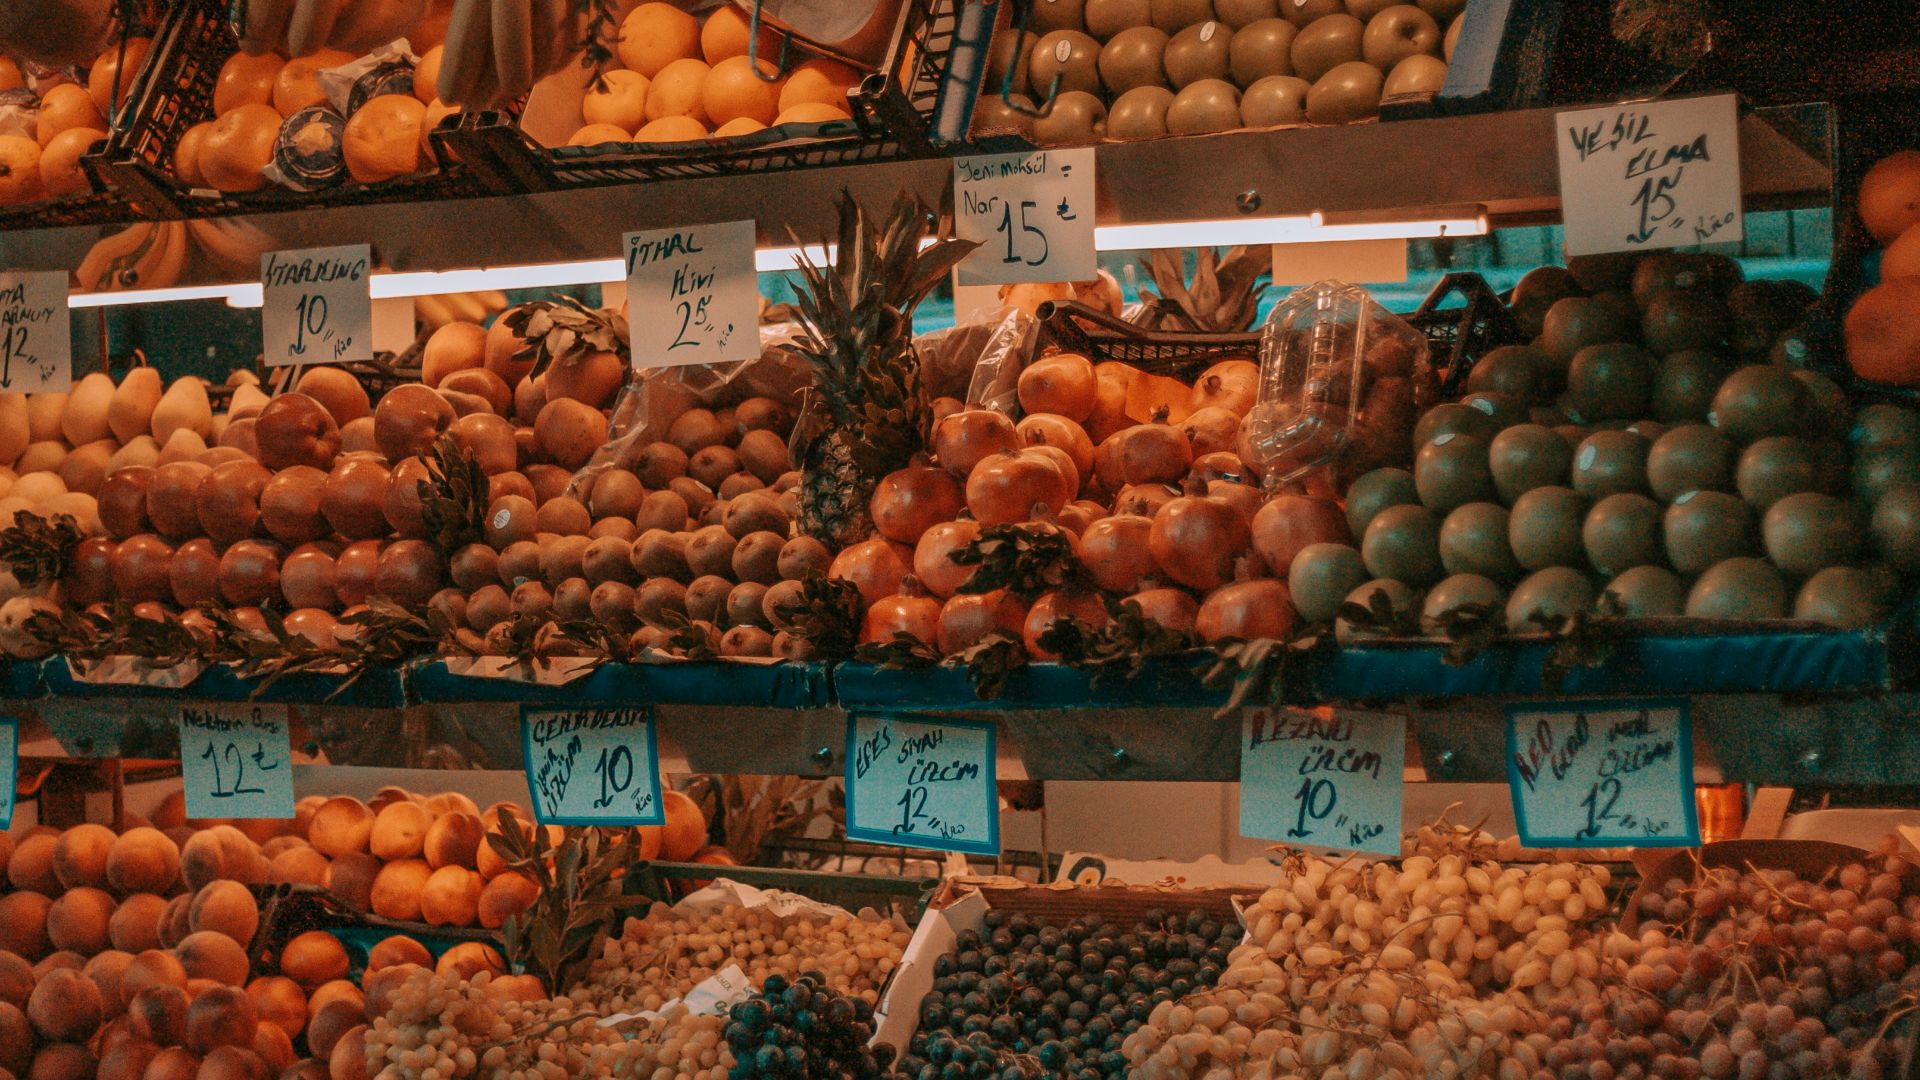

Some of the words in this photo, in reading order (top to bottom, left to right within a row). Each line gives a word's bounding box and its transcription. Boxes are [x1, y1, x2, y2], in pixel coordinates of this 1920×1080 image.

[958, 159, 994, 182] Yeni
[1625, 133, 1710, 179] ELMA
[964, 190, 998, 216] Nar
[997, 200, 1048, 266] 15
[202, 742, 265, 797] 12
[856, 725, 891, 779] EFES
